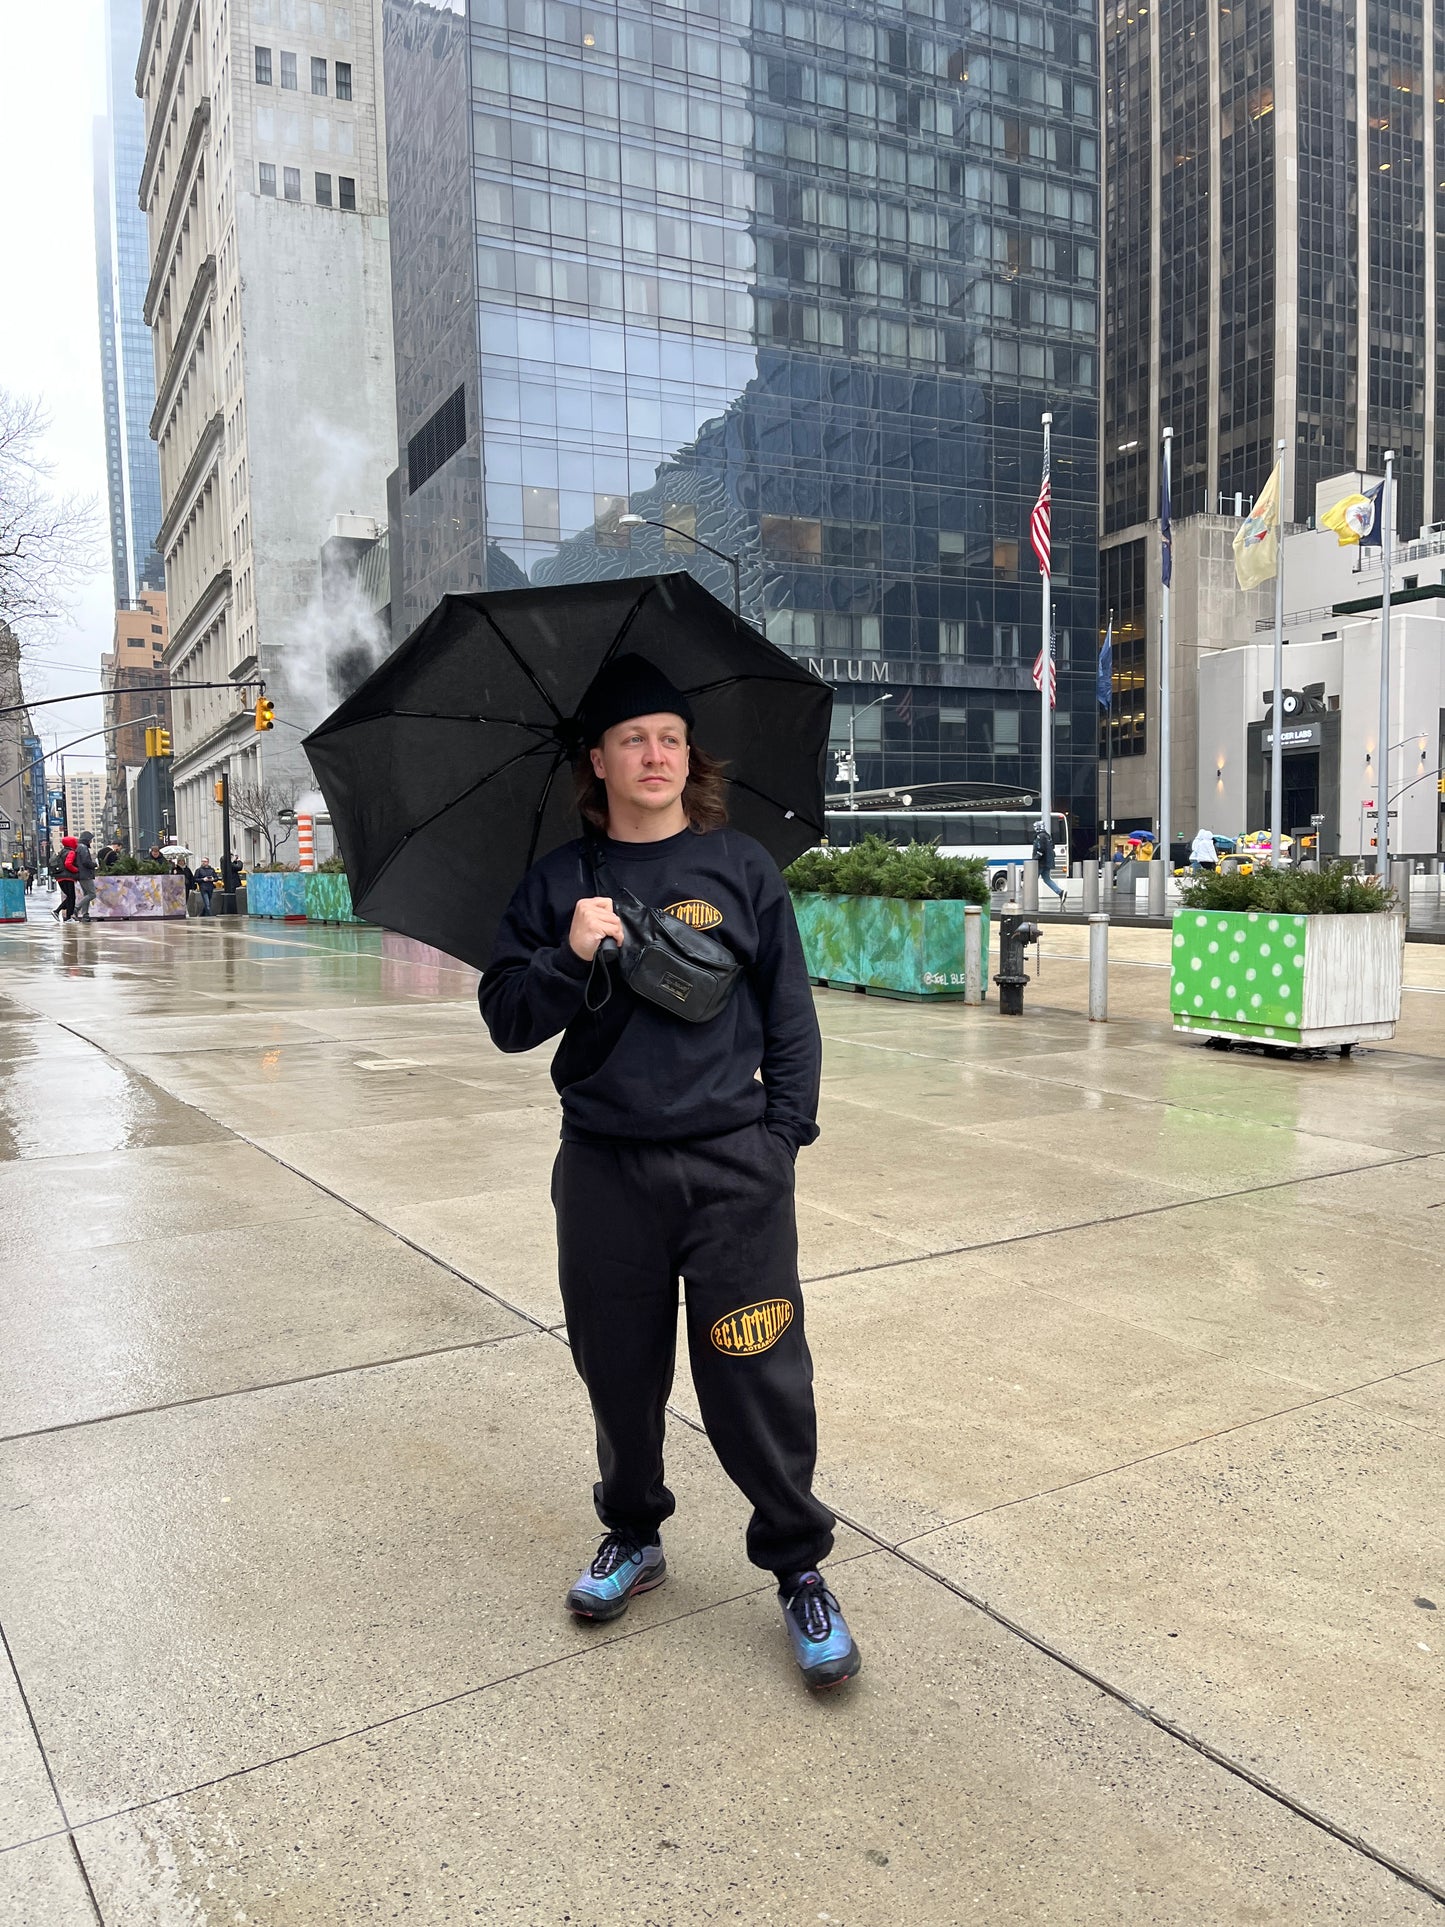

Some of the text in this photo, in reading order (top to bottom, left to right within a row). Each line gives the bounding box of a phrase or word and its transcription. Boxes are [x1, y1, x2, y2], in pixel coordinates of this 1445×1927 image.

[791, 656, 889, 682] NIUM
[1267, 732, 1294, 743] MCER
[1295, 729, 1313, 739] LABS
[670, 903, 719, 926] OTHING
[743, 1336, 776, 1352] AOTEAROA
